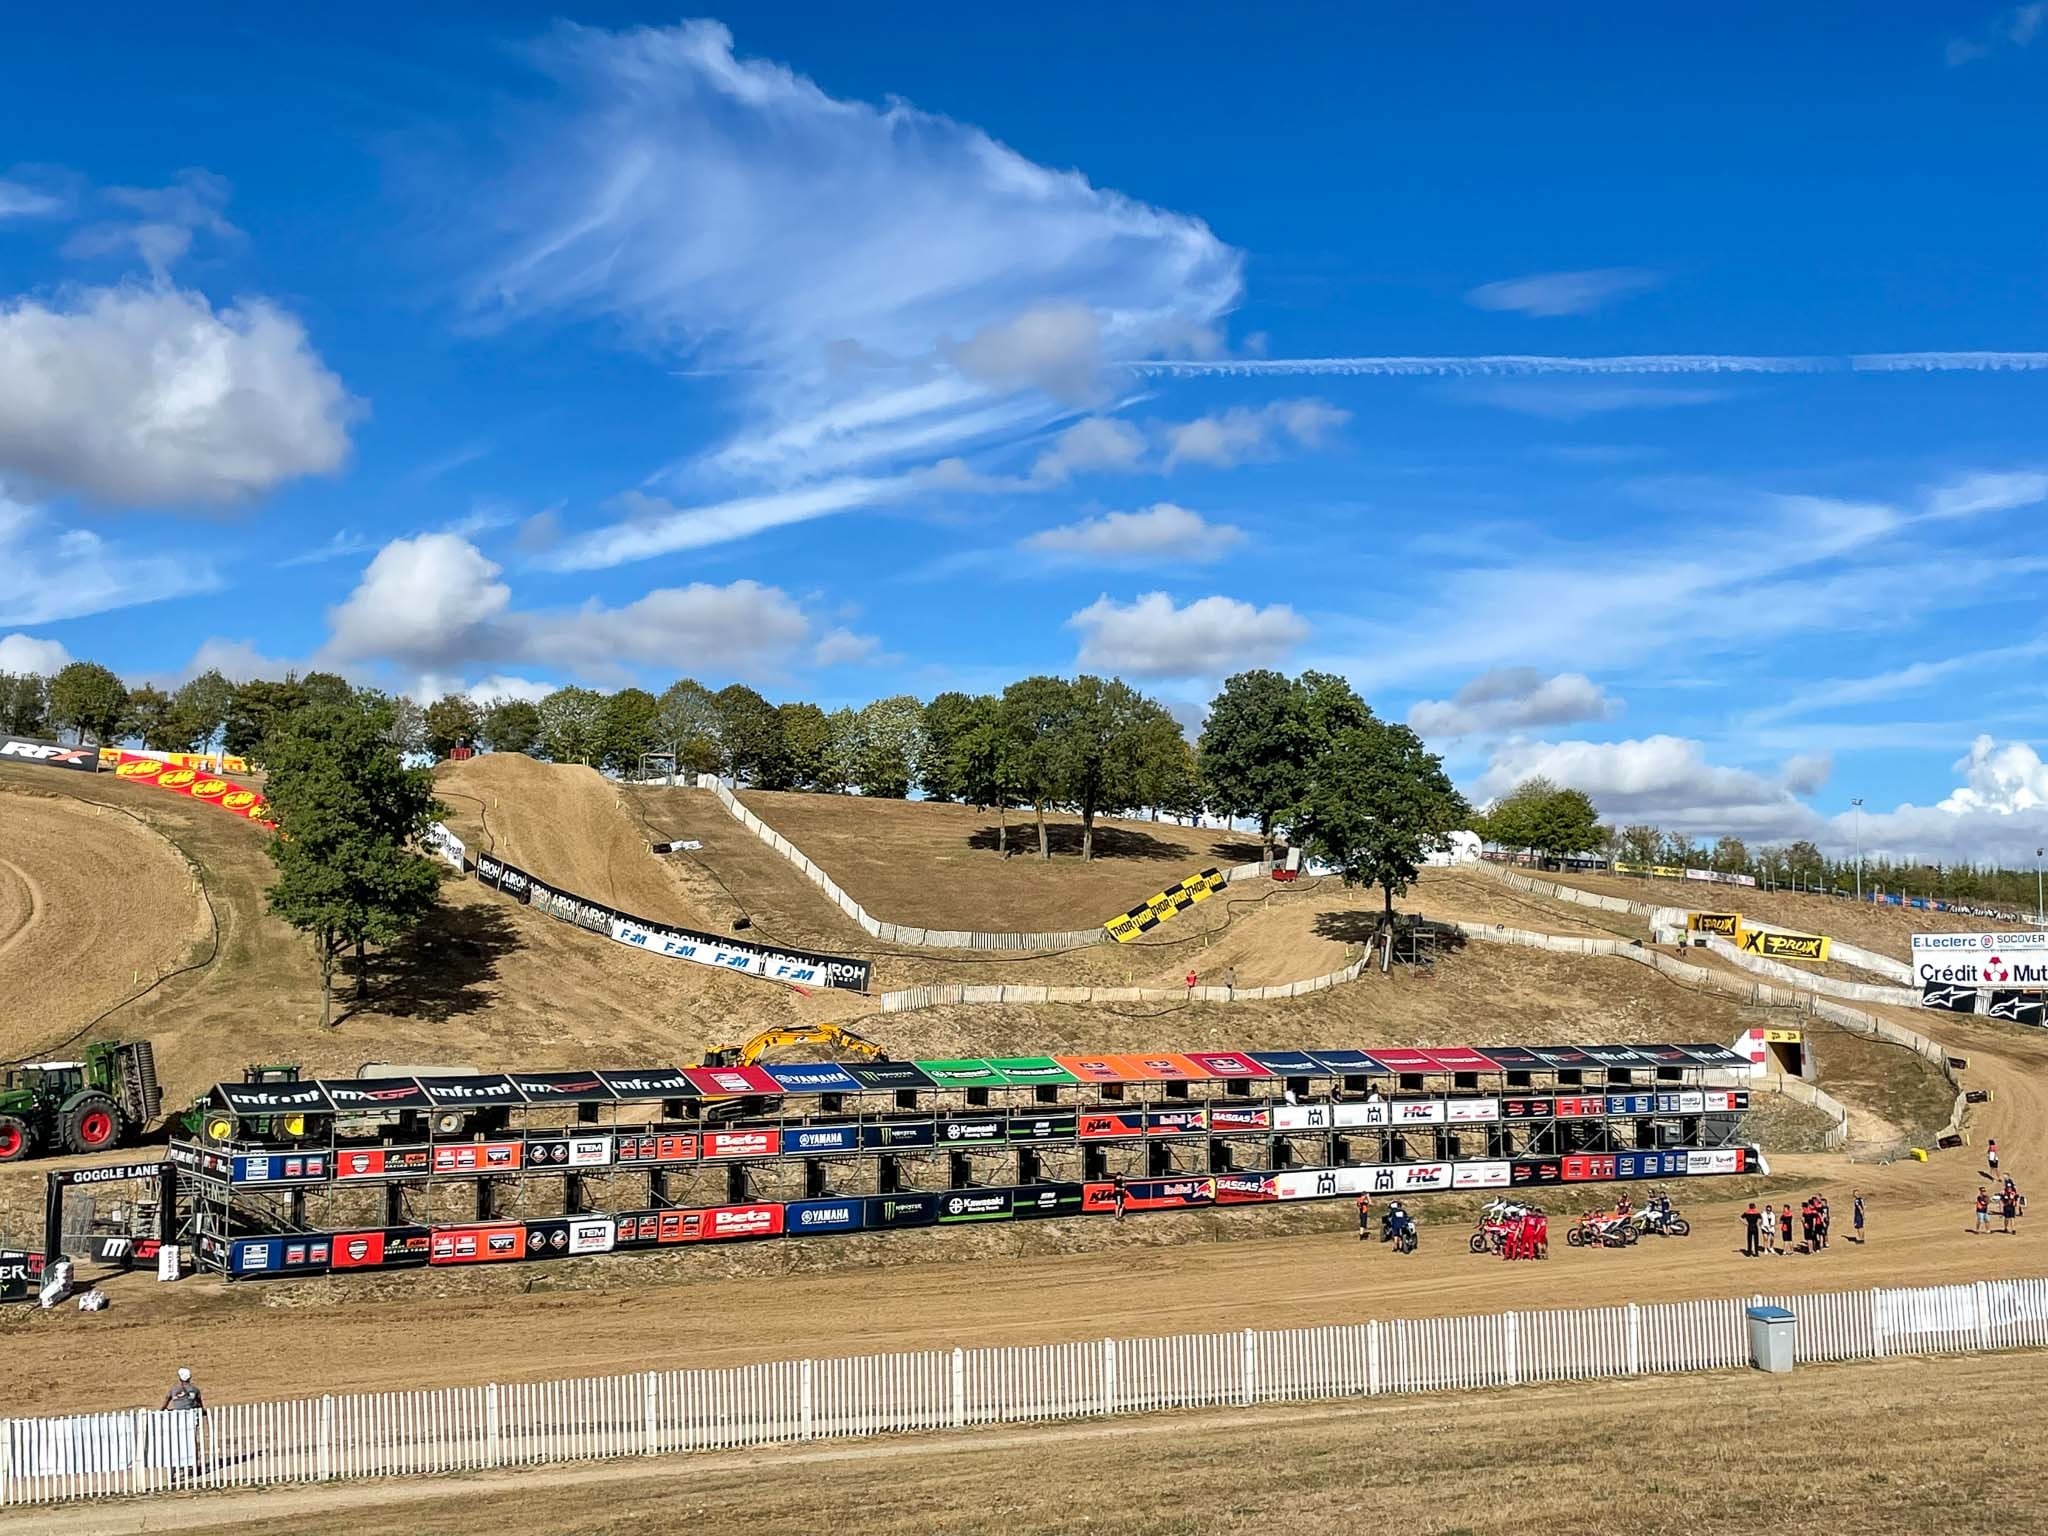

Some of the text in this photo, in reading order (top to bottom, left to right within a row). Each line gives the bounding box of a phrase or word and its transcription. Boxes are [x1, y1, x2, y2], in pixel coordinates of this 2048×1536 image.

[0, 741, 94, 764] RFX
[1111, 920, 1134, 937] THOR
[1913, 937, 1977, 948] E.Leclerc
[1997, 934, 2045, 943] SOCOVER
[1920, 963, 2048, 981] Crédit Mut
[790, 1072, 852, 1084] YAMAHA
[1212, 1112, 1250, 1122] GASGAS
[960, 1123, 997, 1133] Kawasaki
[715, 1134, 767, 1146] Beta
[809, 1132, 843, 1145] YAMAHA
[578, 1144, 602, 1153] TEM
[73, 1164, 160, 1183] GOGGLE LANE
[1406, 1167, 1442, 1184] HRC
[1217, 1180, 1259, 1191] GASGAS
[964, 1196, 1004, 1207] Kawasaki
[716, 1210, 771, 1224] Beta
[812, 1208, 849, 1221] YAMAHA
[580, 1228, 606, 1237] TEM
